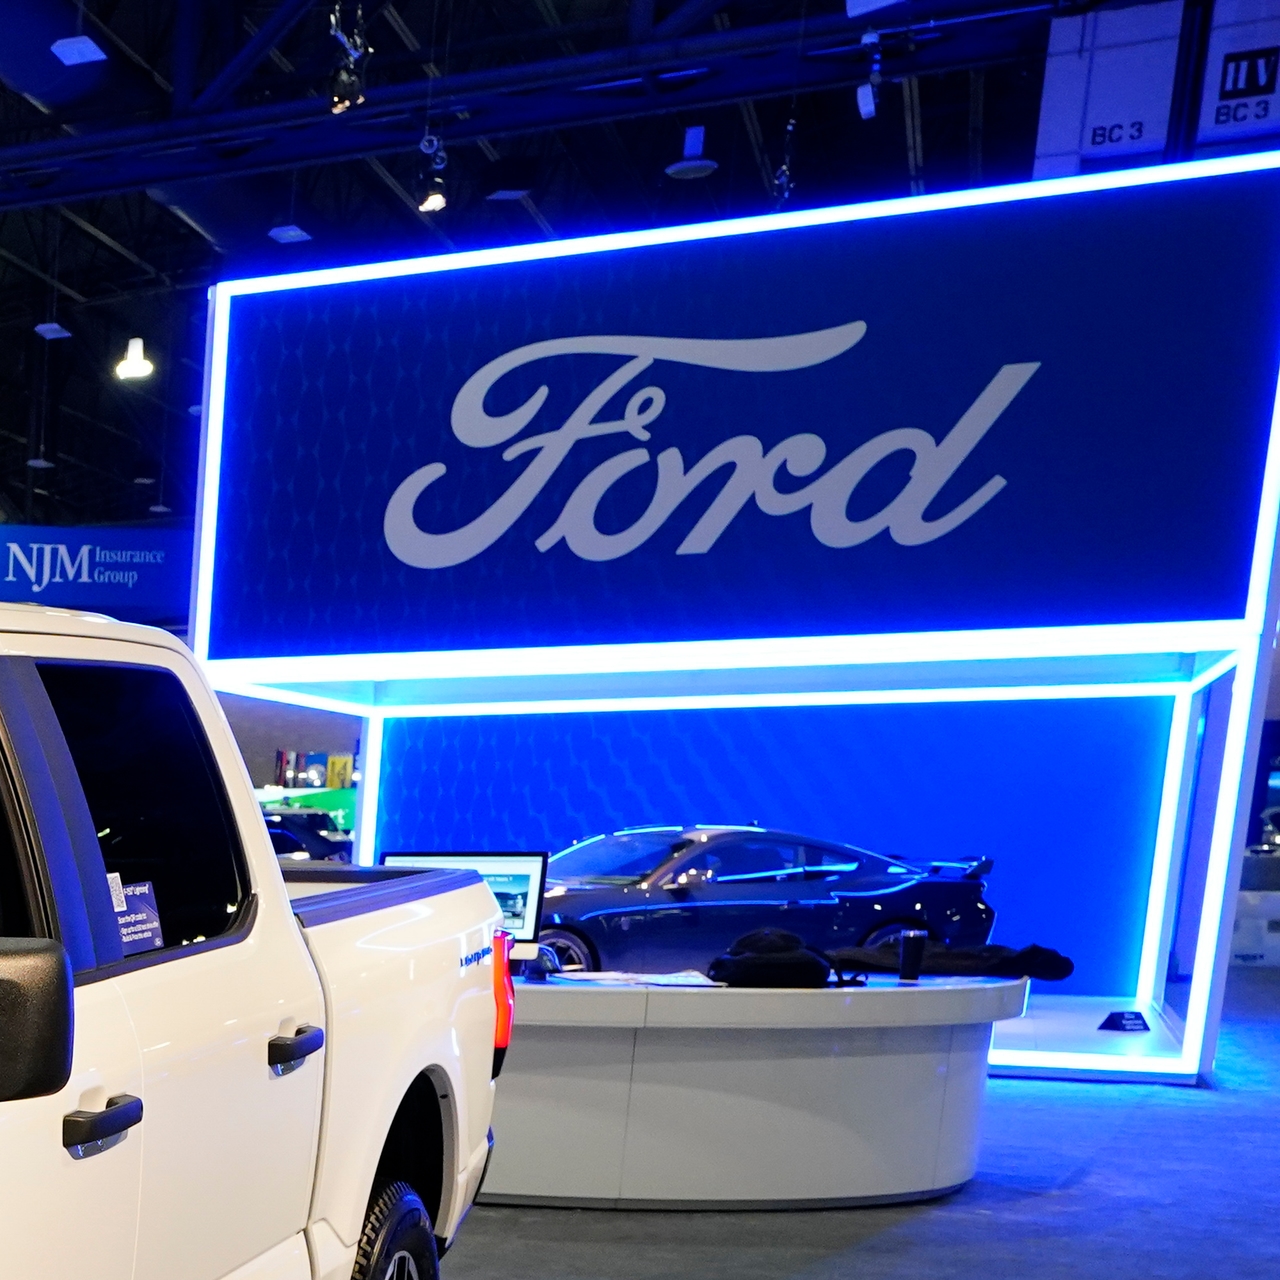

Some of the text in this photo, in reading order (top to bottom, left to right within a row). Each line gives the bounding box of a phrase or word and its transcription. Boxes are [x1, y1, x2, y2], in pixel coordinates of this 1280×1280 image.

[1215, 99, 1270, 125] BC 3
[1091, 121, 1144, 146] BC 3
[383, 319, 1041, 570] Ford
[4, 542, 165, 593] NJM Insurance
[94, 566, 138, 588] Group
